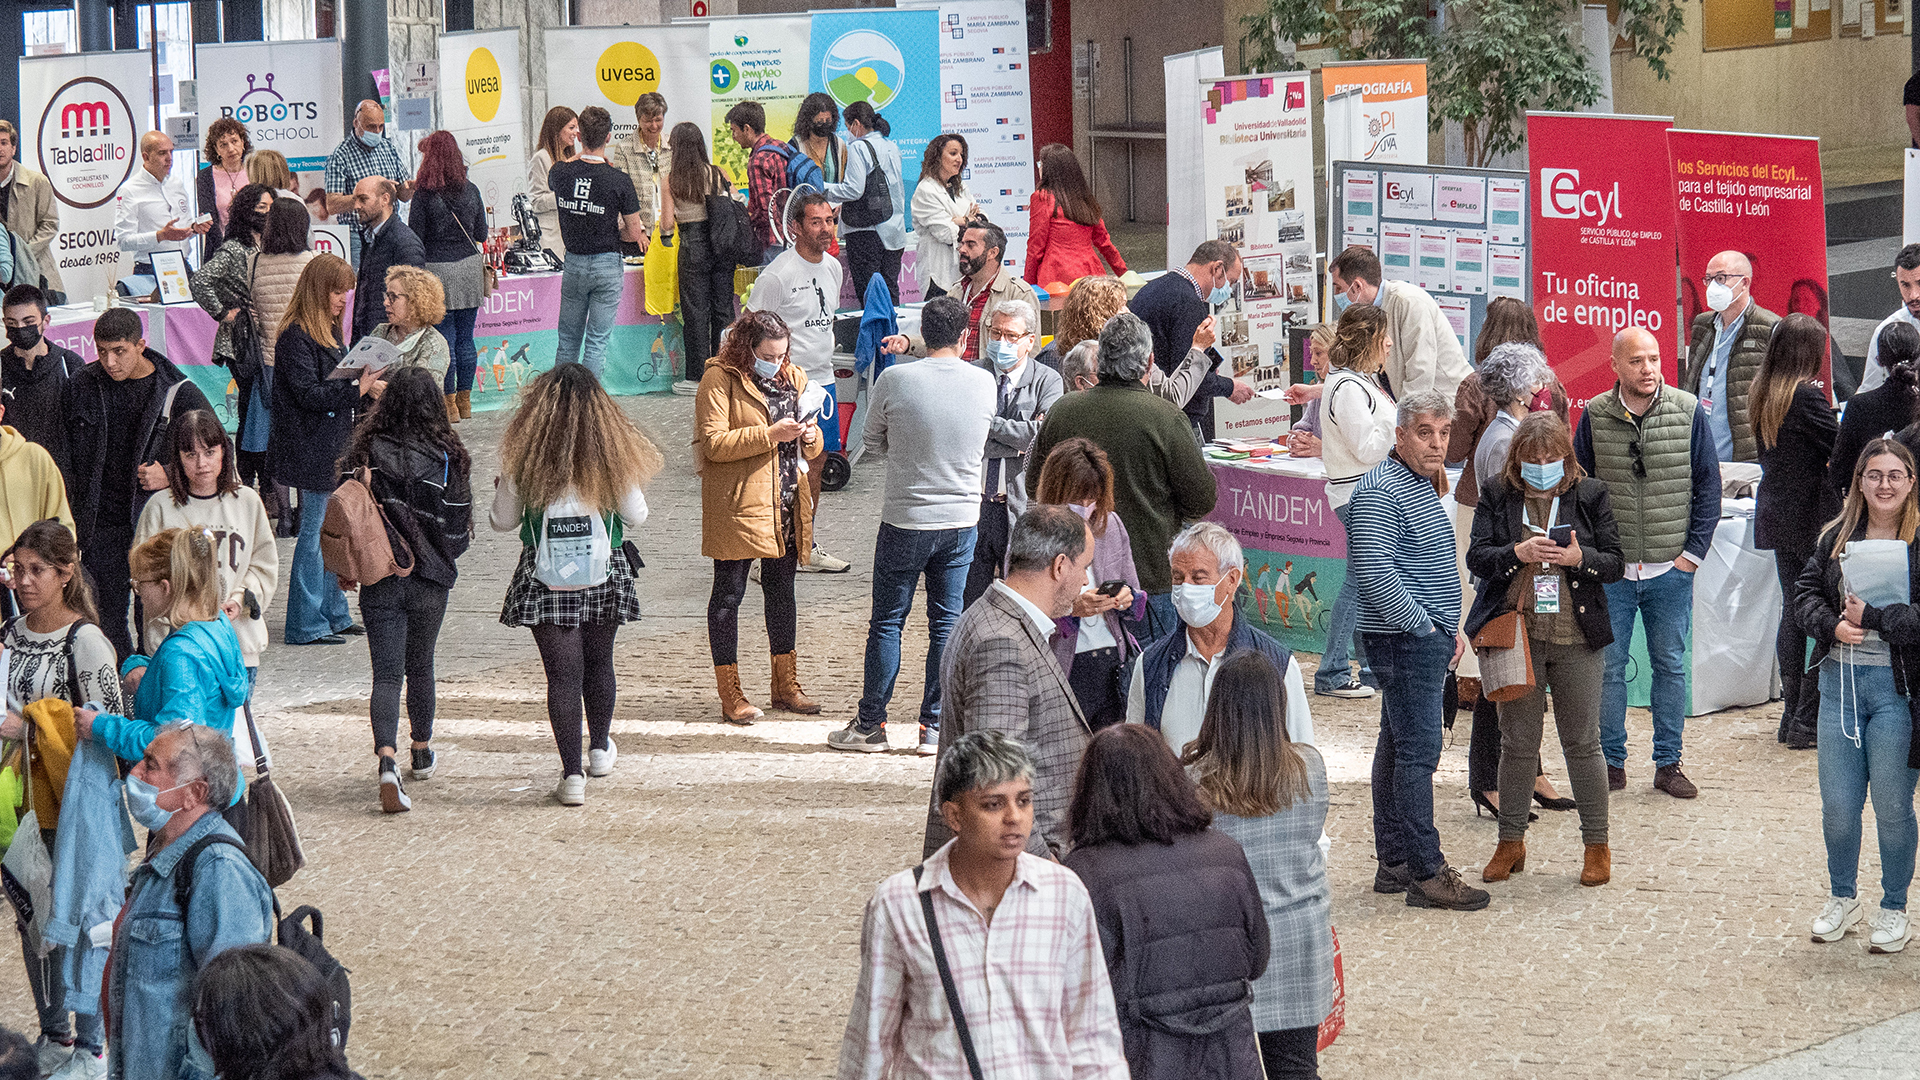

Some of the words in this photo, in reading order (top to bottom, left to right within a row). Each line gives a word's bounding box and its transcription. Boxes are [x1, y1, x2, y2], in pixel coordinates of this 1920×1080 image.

[742, 59, 782, 69] empresas
[601, 67, 655, 82] uvesa
[742, 67, 782, 81] empleo
[467, 76, 499, 94] uvesa
[744, 80, 778, 92] RURAL
[220, 102, 318, 123] ROBOTS
[257, 127, 318, 142] SCHOOL
[466, 136, 492, 147] Avanzando
[493, 133, 512, 144] contigo
[899, 138, 930, 146] INTEGRAL
[1220, 133, 1259, 145] Biblioteca
[1260, 128, 1307, 141] Universitaria
[50, 143, 125, 165] Tabladillo
[1677, 159, 1693, 174] los
[1697, 160, 1749, 178] Servicios
[1752, 163, 1768, 179] del
[66, 175, 98, 183] ESPECIALISTAS
[72, 182, 104, 190] COCHINILLOS
[1678, 180, 1700, 195] para
[1704, 179, 1714, 194] el
[1717, 180, 1746, 198] tejido
[1748, 184, 1812, 200] empresarial
[558, 197, 578, 210] Guni
[580, 201, 605, 215] Films
[1679, 196, 1692, 212] de
[1694, 197, 1733, 214] Castilla
[1736, 202, 1742, 218] y
[1745, 200, 1770, 217] León
[1580, 227, 1606, 236] SERVICIO
[1606, 228, 1631, 238] PÚBLICO
[1631, 230, 1639, 238] de
[1640, 230, 1662, 240] EMPLEO
[1250, 243, 1274, 251] Biblioteca
[1580, 236, 1588, 244] de
[1588, 237, 1615, 246] CASTILLA
[1616, 238, 1620, 246] Y
[1621, 237, 1636, 247] LEÓN
[59, 254, 93, 268] desde
[94, 251, 120, 264] 1968
[1542, 272, 1568, 294] Tu
[1574, 273, 1640, 300] oficina
[477, 289, 534, 315] NDEM
[804, 318, 832, 328] BARCA
[1544, 300, 1568, 324] de
[1574, 300, 1662, 334] empleo
[1256, 322, 1274, 330] Segovia
[1224, 421, 1234, 430] Te
[1234, 418, 1263, 429] estamos
[1264, 414, 1290, 425] esperan
[1230, 484, 1323, 527] TÁNDEM
[551, 522, 589, 534] TÁNDEM
[1241, 528, 1260, 538] Empleo
[1264, 531, 1286, 541] Empresa
[1286, 534, 1304, 544] Segovia
[1309, 537, 1331, 546] Provincia
